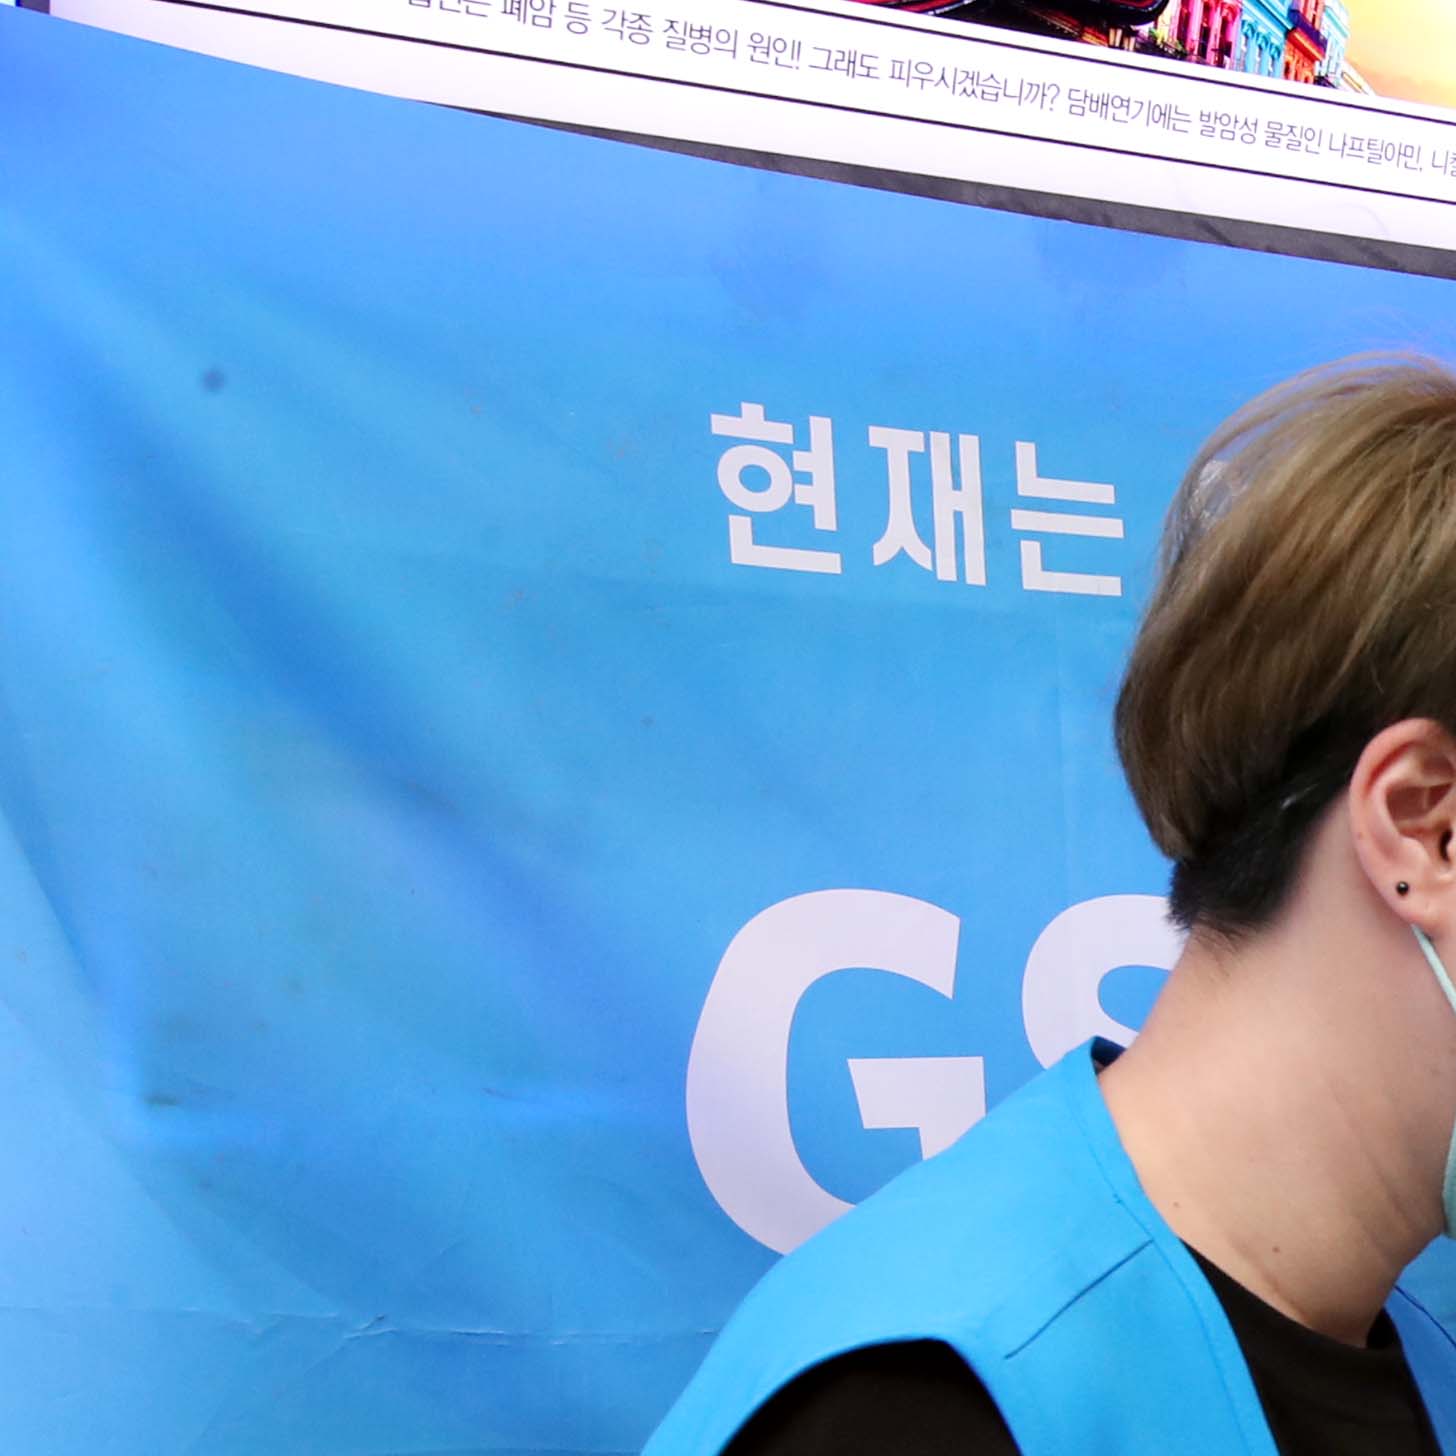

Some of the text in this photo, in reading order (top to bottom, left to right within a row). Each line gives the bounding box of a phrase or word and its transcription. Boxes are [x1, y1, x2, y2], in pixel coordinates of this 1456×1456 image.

[564, 1, 592, 35] 등
[600, 8, 653, 45] 각종
[662, 18, 739, 60] 질병의
[747, 31, 800, 70] 원인!
[808, 46, 881, 79] 그래도
[889, 58, 1060, 111] 피우시겠습니까?
[1066, 88, 1193, 135] 담배연기에는
[1199, 109, 1259, 145] 발암성
[1264, 119, 1323, 155] 물질인
[1328, 132, 1425, 173] 나프틸아민,
[711, 402, 1123, 597] 현재는
